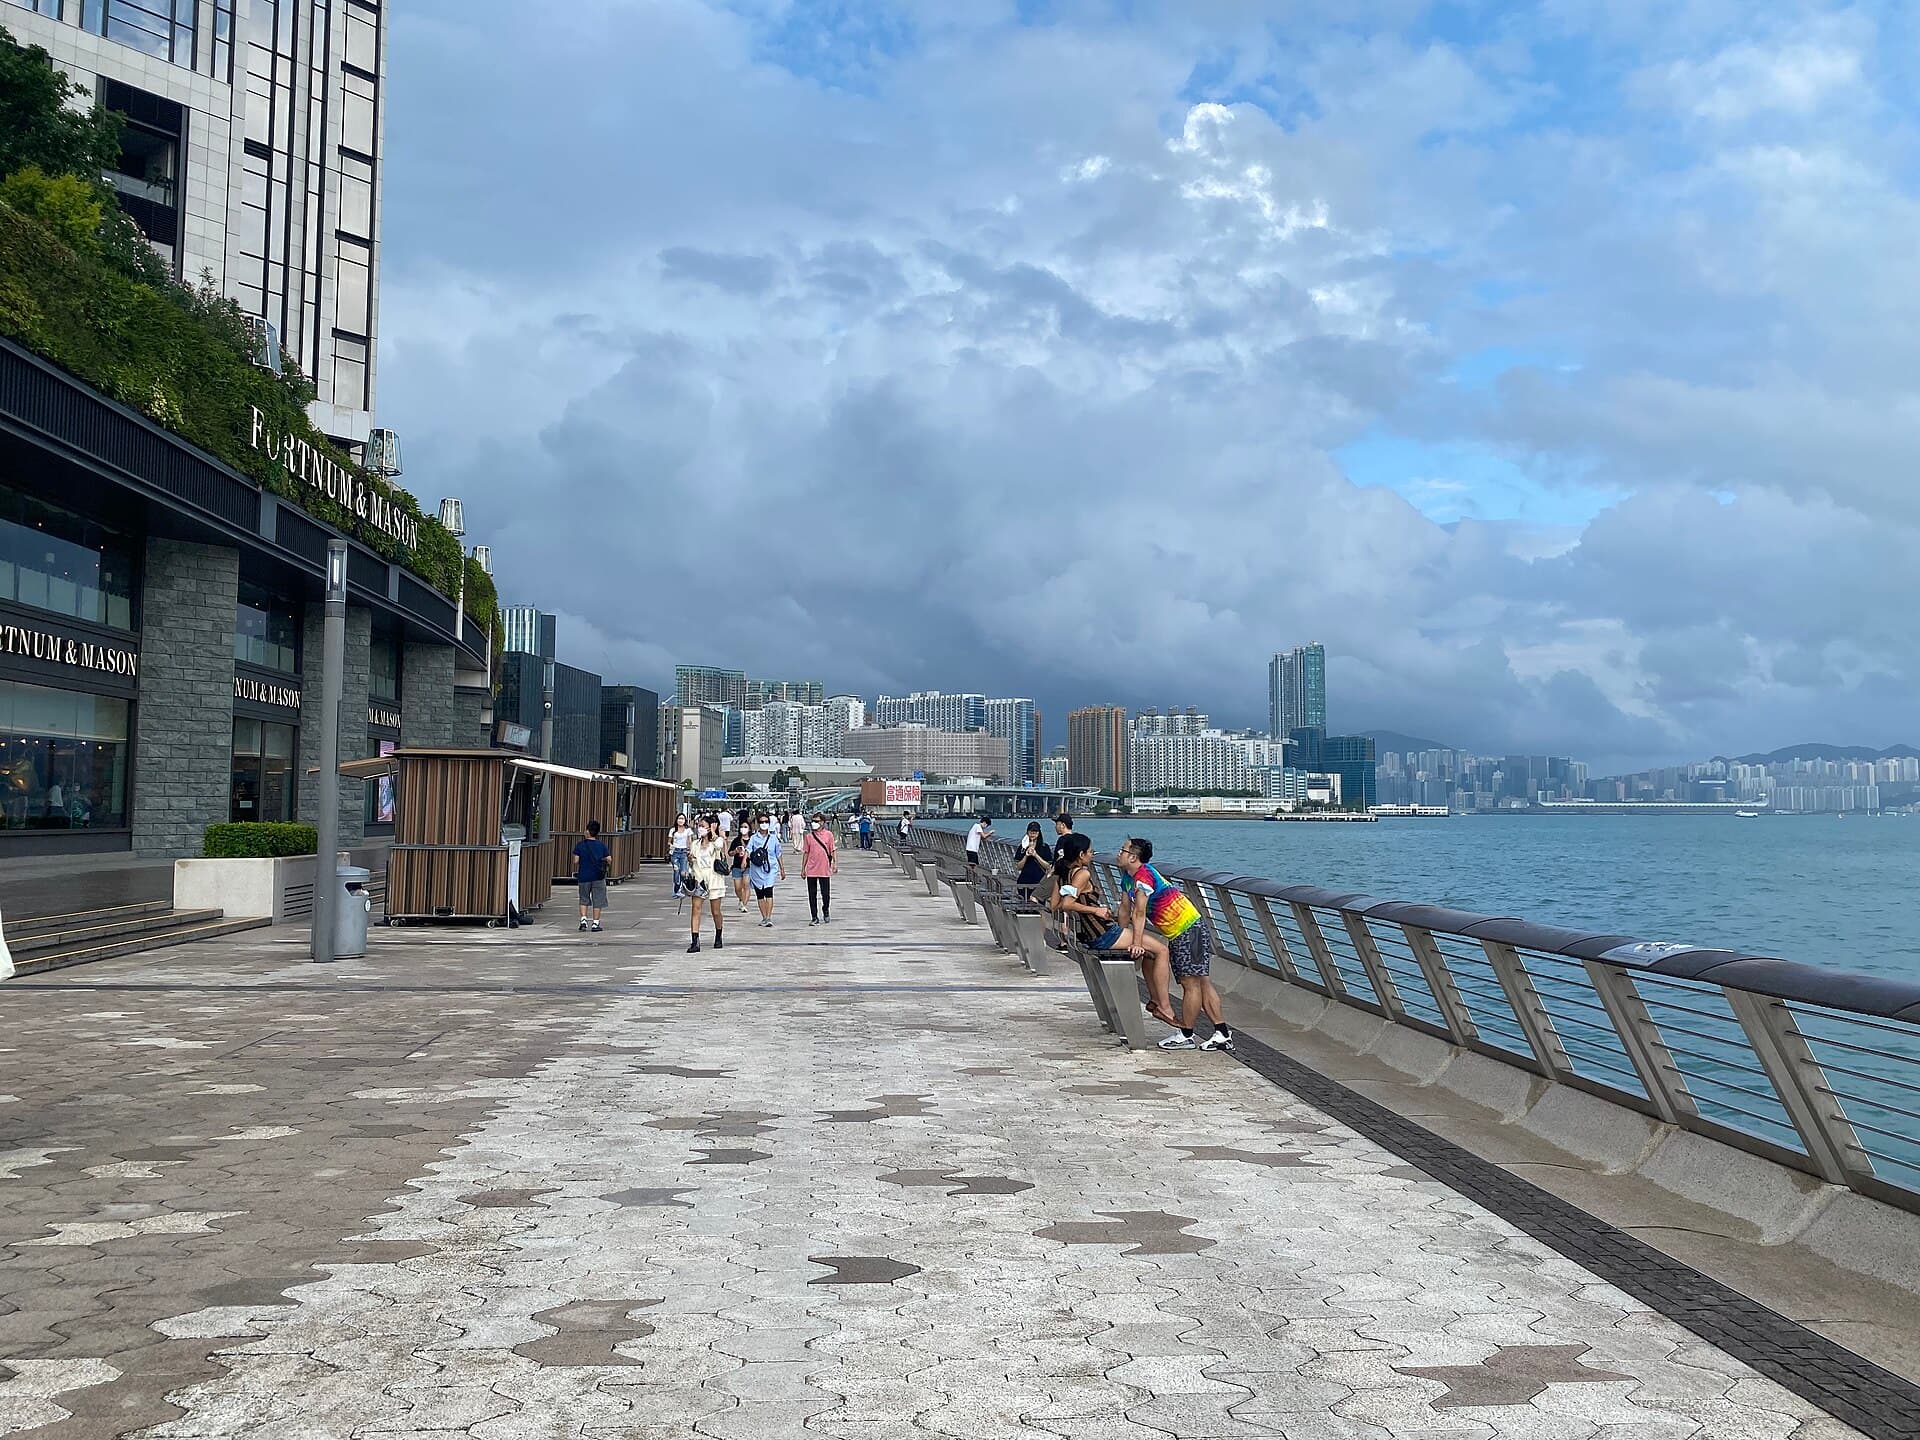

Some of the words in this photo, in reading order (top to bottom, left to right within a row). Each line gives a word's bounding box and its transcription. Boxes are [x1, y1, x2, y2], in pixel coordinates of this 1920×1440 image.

[250, 404, 353, 511] FORTNUM
[356, 482, 367, 519] &
[370, 491, 418, 551] MASON
[0, 624, 62, 662] TNUM
[65, 640, 78, 665] &
[80, 642, 137, 676] MASON
[260, 683, 267, 702] &
[268, 685, 300, 709] MASON
[380, 710, 401, 728] MASON
